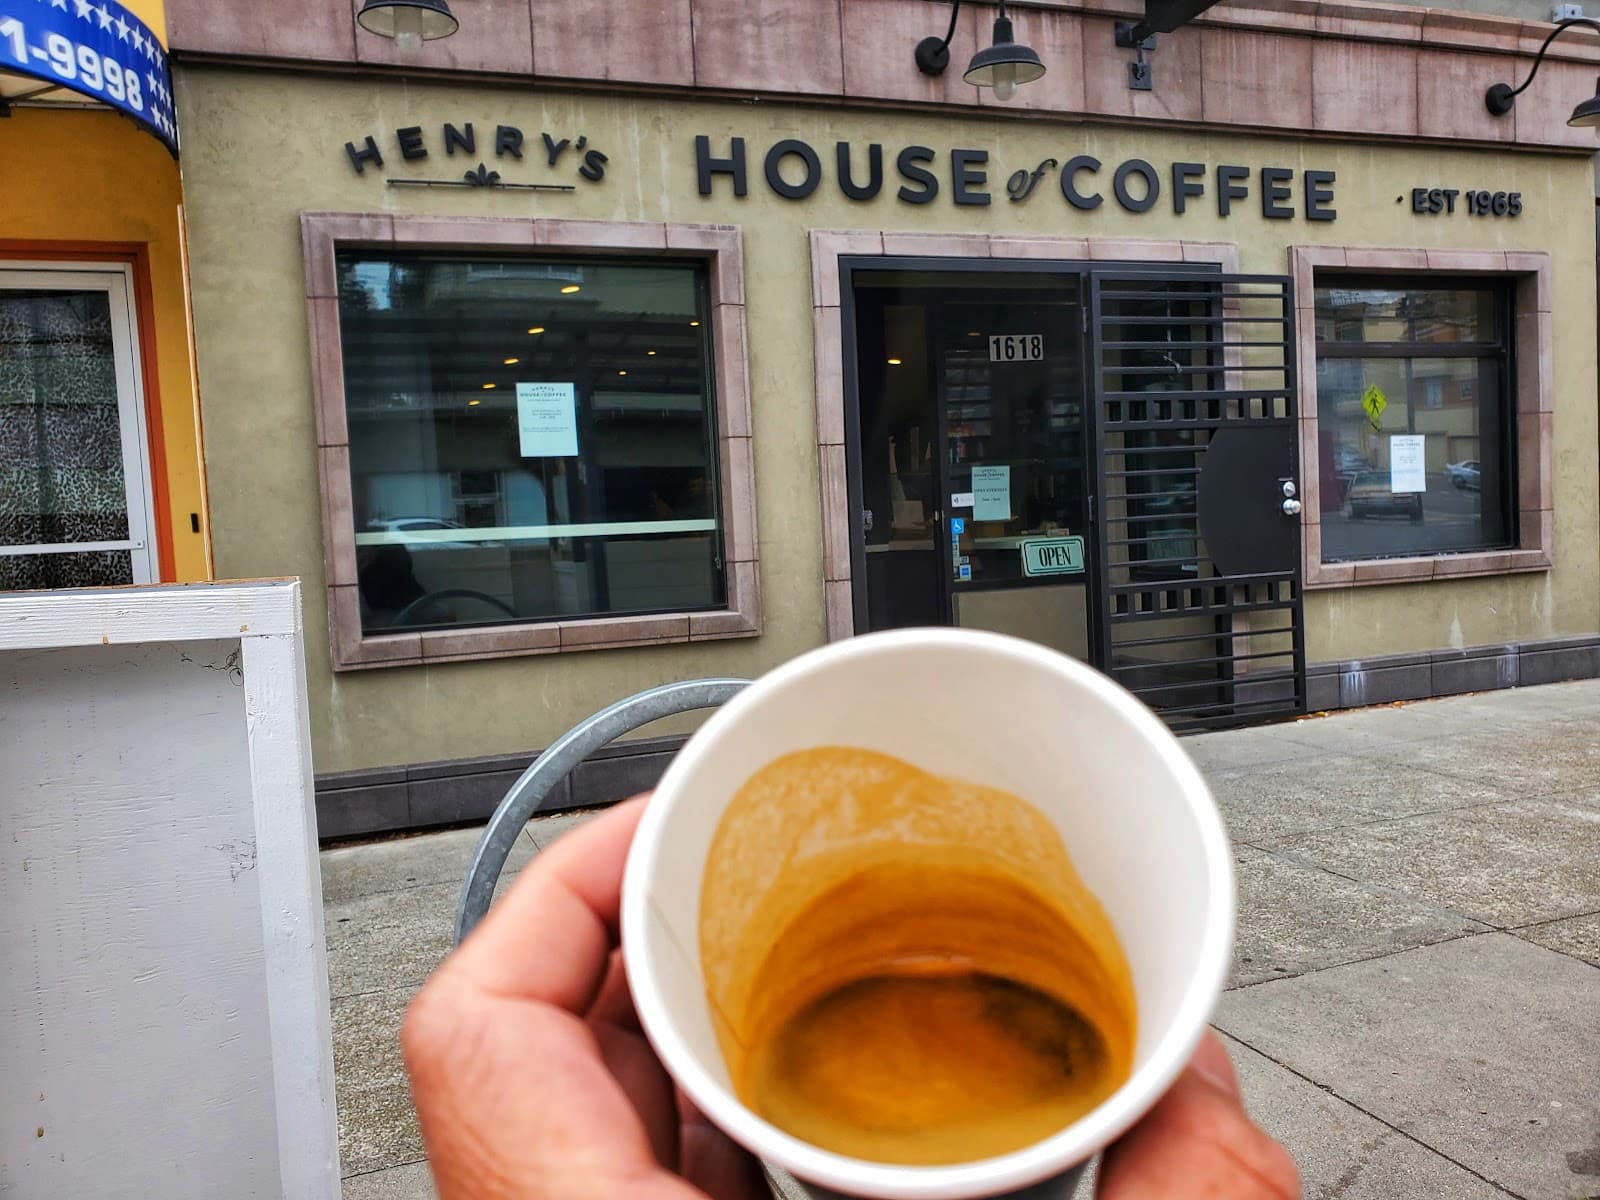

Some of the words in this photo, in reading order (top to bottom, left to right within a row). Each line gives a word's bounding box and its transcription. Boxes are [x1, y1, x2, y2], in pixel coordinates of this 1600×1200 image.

[0, 17, 144, 112] 1-9998
[345, 122, 609, 182] HENRY'S
[695, 134, 991, 206] HOUSE
[1006, 158, 1058, 202] of
[1060, 155, 1338, 221] COFFEE
[1412, 187, 1459, 214] EST
[1465, 189, 1523, 217] 1965
[992, 336, 1041, 361] 1618
[1038, 546, 1072, 568] OPEN
